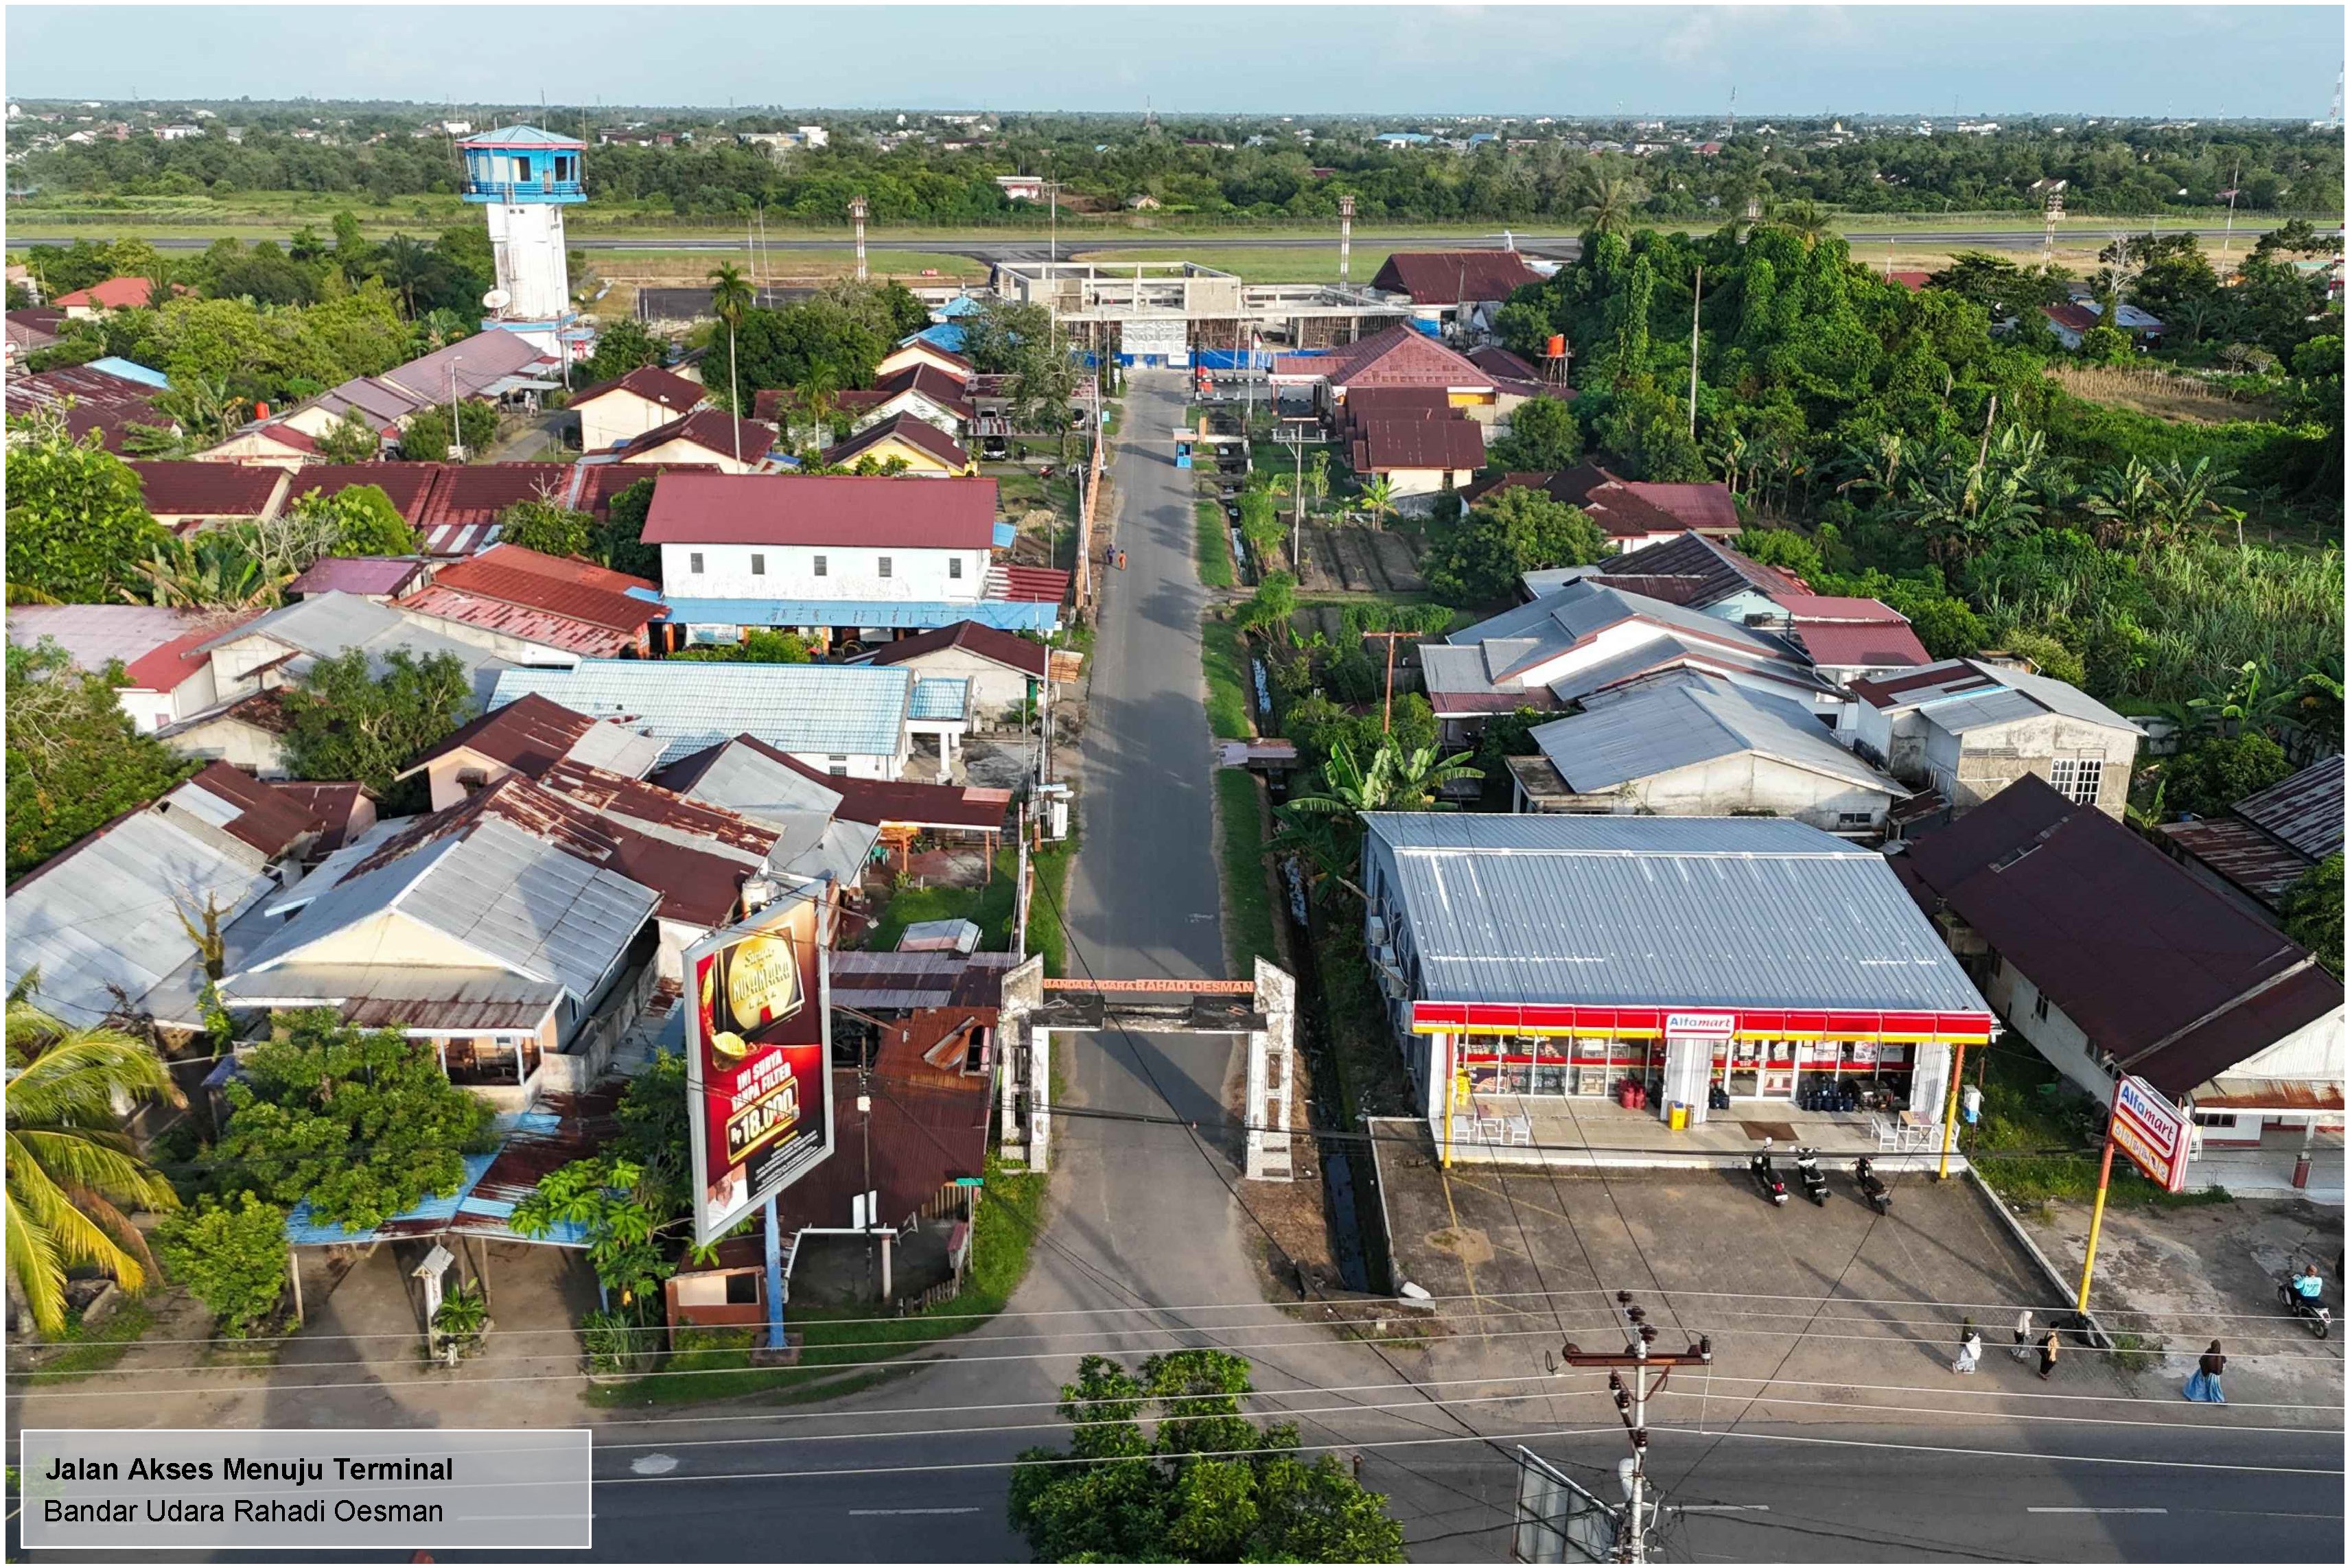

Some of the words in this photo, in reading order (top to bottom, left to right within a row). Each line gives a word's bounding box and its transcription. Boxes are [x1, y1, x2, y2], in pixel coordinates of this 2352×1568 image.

[1043, 979, 1091, 990] BANDAR
[1136, 979, 1193, 992] RAHADI
[1194, 981, 1254, 993] OESMAN
[1670, 1017, 1731, 1027] Alfamart
[731, 1082, 760, 1112] TANPA
[761, 1062, 792, 1093] FILTER
[736, 1068, 752, 1091] INI
[753, 1049, 783, 1080] SURYA
[2120, 1085, 2174, 1142] Alfamart
